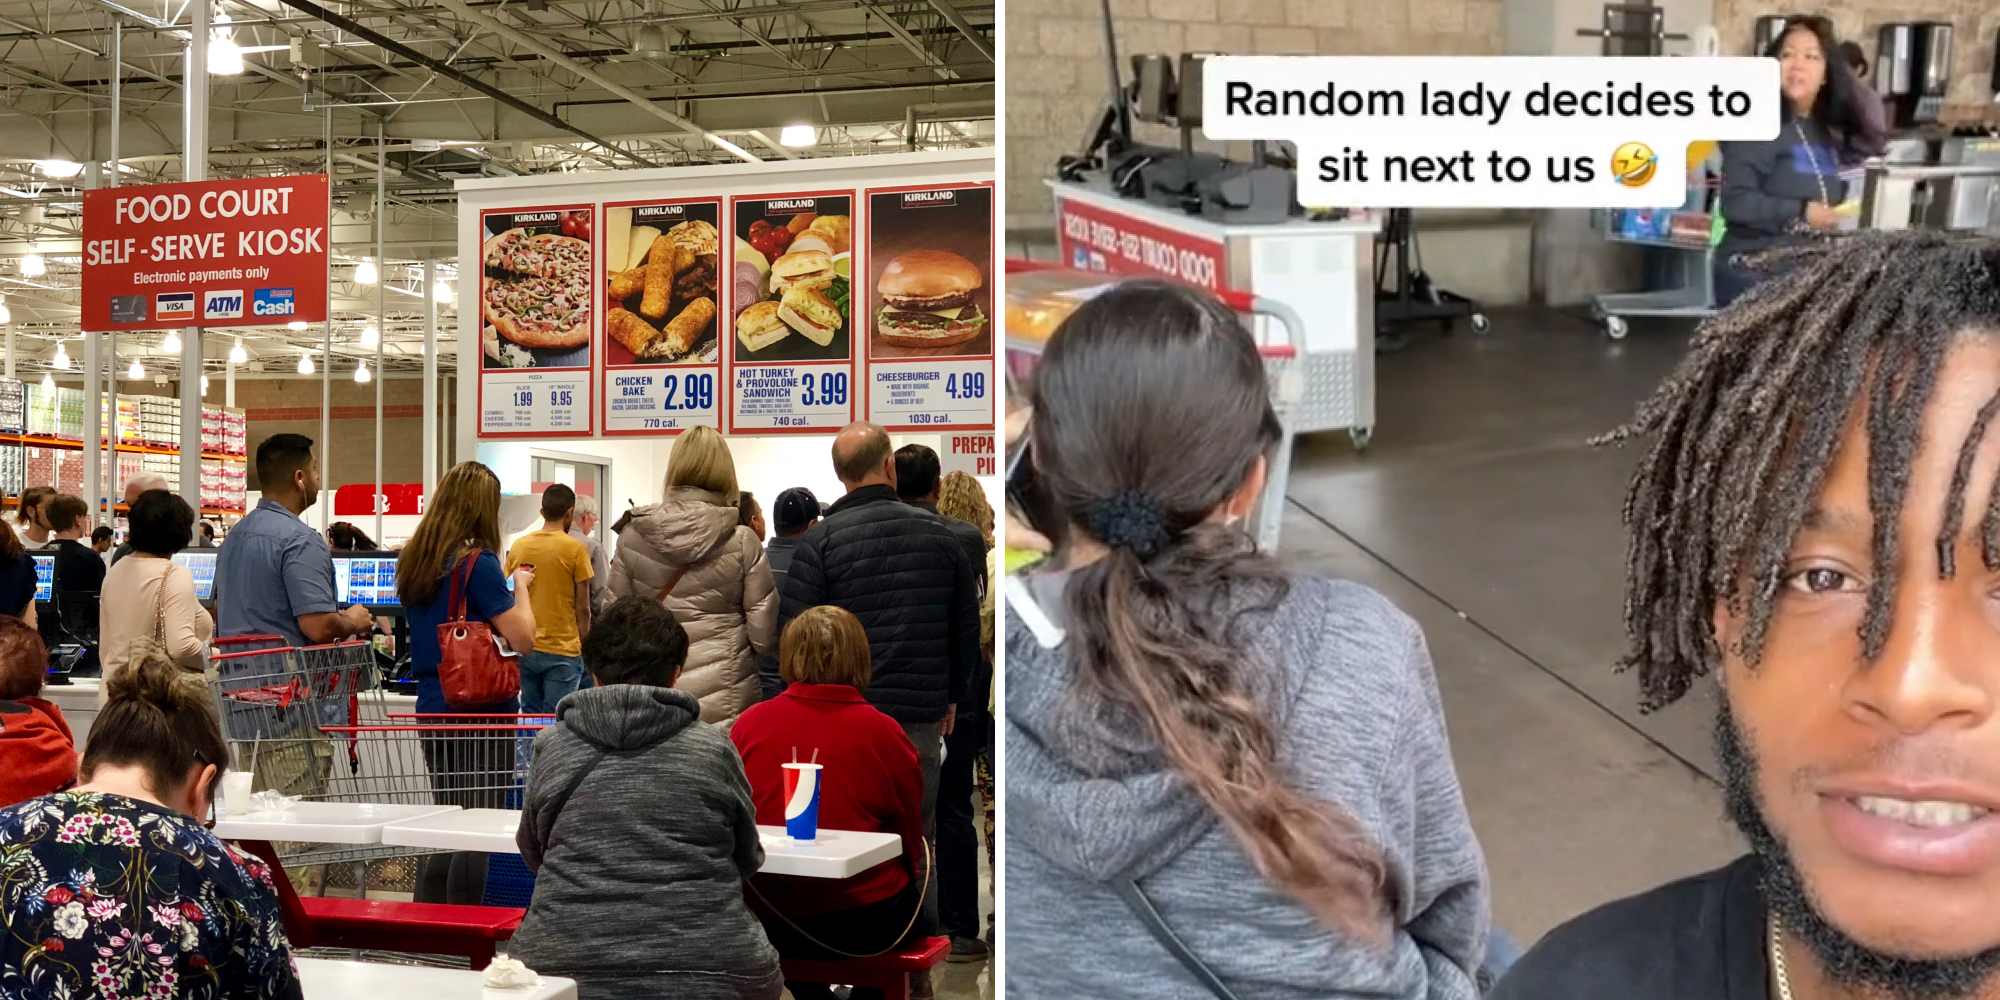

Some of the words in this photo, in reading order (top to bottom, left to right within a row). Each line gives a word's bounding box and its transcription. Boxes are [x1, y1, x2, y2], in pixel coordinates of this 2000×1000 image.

[904, 191, 954, 202] KIRKLAND
[115, 194, 191, 224] FOOD
[200, 187, 294, 219] COURT
[768, 199, 814, 209] KIRKLAND
[638, 206, 683, 216] KIRKLAND
[514, 213, 557, 223] KIRKLAND
[238, 227, 323, 257] KIOSK
[133, 270, 186, 285] Electronic
[188, 267, 242, 284] payments
[246, 266, 270, 280] only
[166, 302, 184, 311] VISA
[206, 296, 242, 313] ATM
[253, 298, 294, 316] Cash
[740, 369, 757, 378] HOT
[760, 368, 795, 378] TURKEY
[876, 372, 940, 382] CHEESEBURGER
[615, 376, 652, 386] CHICKEN
[736, 380, 743, 388] &
[746, 378, 798, 388] PROVOLONE
[945, 372, 985, 399] 4.99
[622, 387, 645, 396] BAKE
[664, 374, 712, 410] 2.99
[743, 388, 790, 398] SANDWICH
[802, 372, 847, 406] 3.99
[513, 391, 532, 406] 1.99
[551, 391, 572, 406] 9.95
[644, 419, 660, 428] 770
[662, 418, 678, 427] cal.
[773, 416, 790, 426] 740
[792, 416, 809, 425] cal.
[908, 414, 931, 423] 1030
[934, 414, 951, 423] cal.
